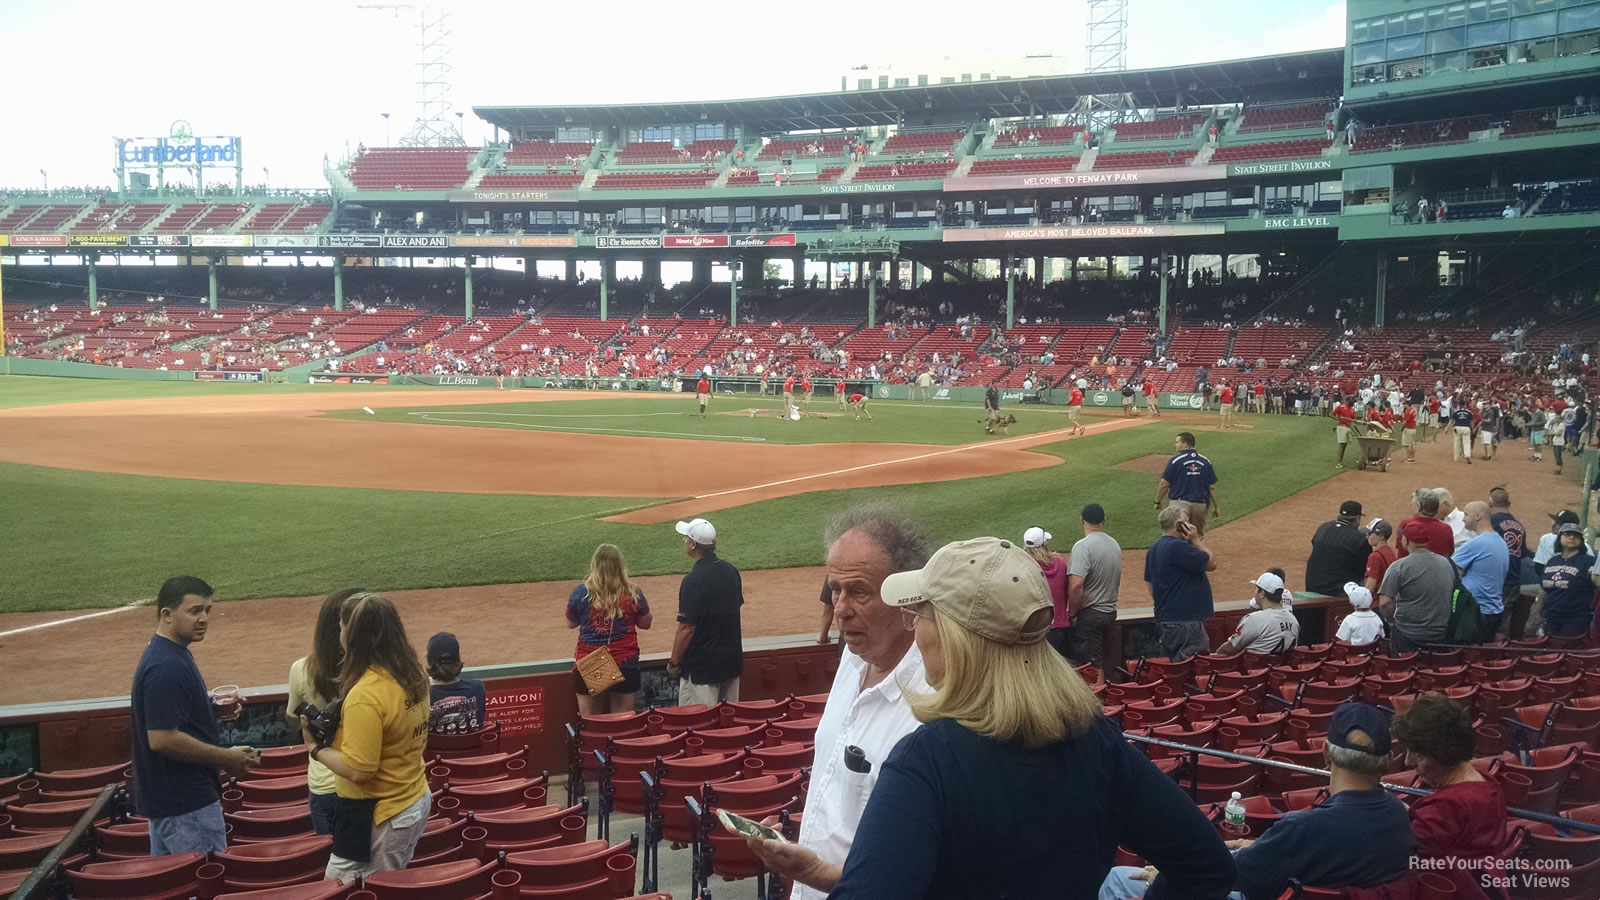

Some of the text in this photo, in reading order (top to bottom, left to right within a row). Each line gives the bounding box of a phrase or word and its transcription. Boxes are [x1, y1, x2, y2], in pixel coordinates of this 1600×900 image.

[120, 136, 235, 162] Cumberland
[1234, 161, 1331, 174] STATE STREET PAVILION
[1023, 173, 1138, 186] WELCOME TO FENWAY PARK
[840, 184, 862, 193] STREET
[864, 183, 895, 192] PAVILION
[474, 192, 549, 200] TONIGHT'S STARTERS
[1265, 217, 1330, 228] EMC LEVEL
[1005, 226, 1155, 238] AMERICA'S MOST BELOVED BALLPARK
[386, 237, 406, 246] ALEX
[409, 237, 429, 246] AND
[430, 237, 445, 246] ANI
[609, 238, 658, 246] The Boston Globe
[1280, 622, 1293, 632] BAY
